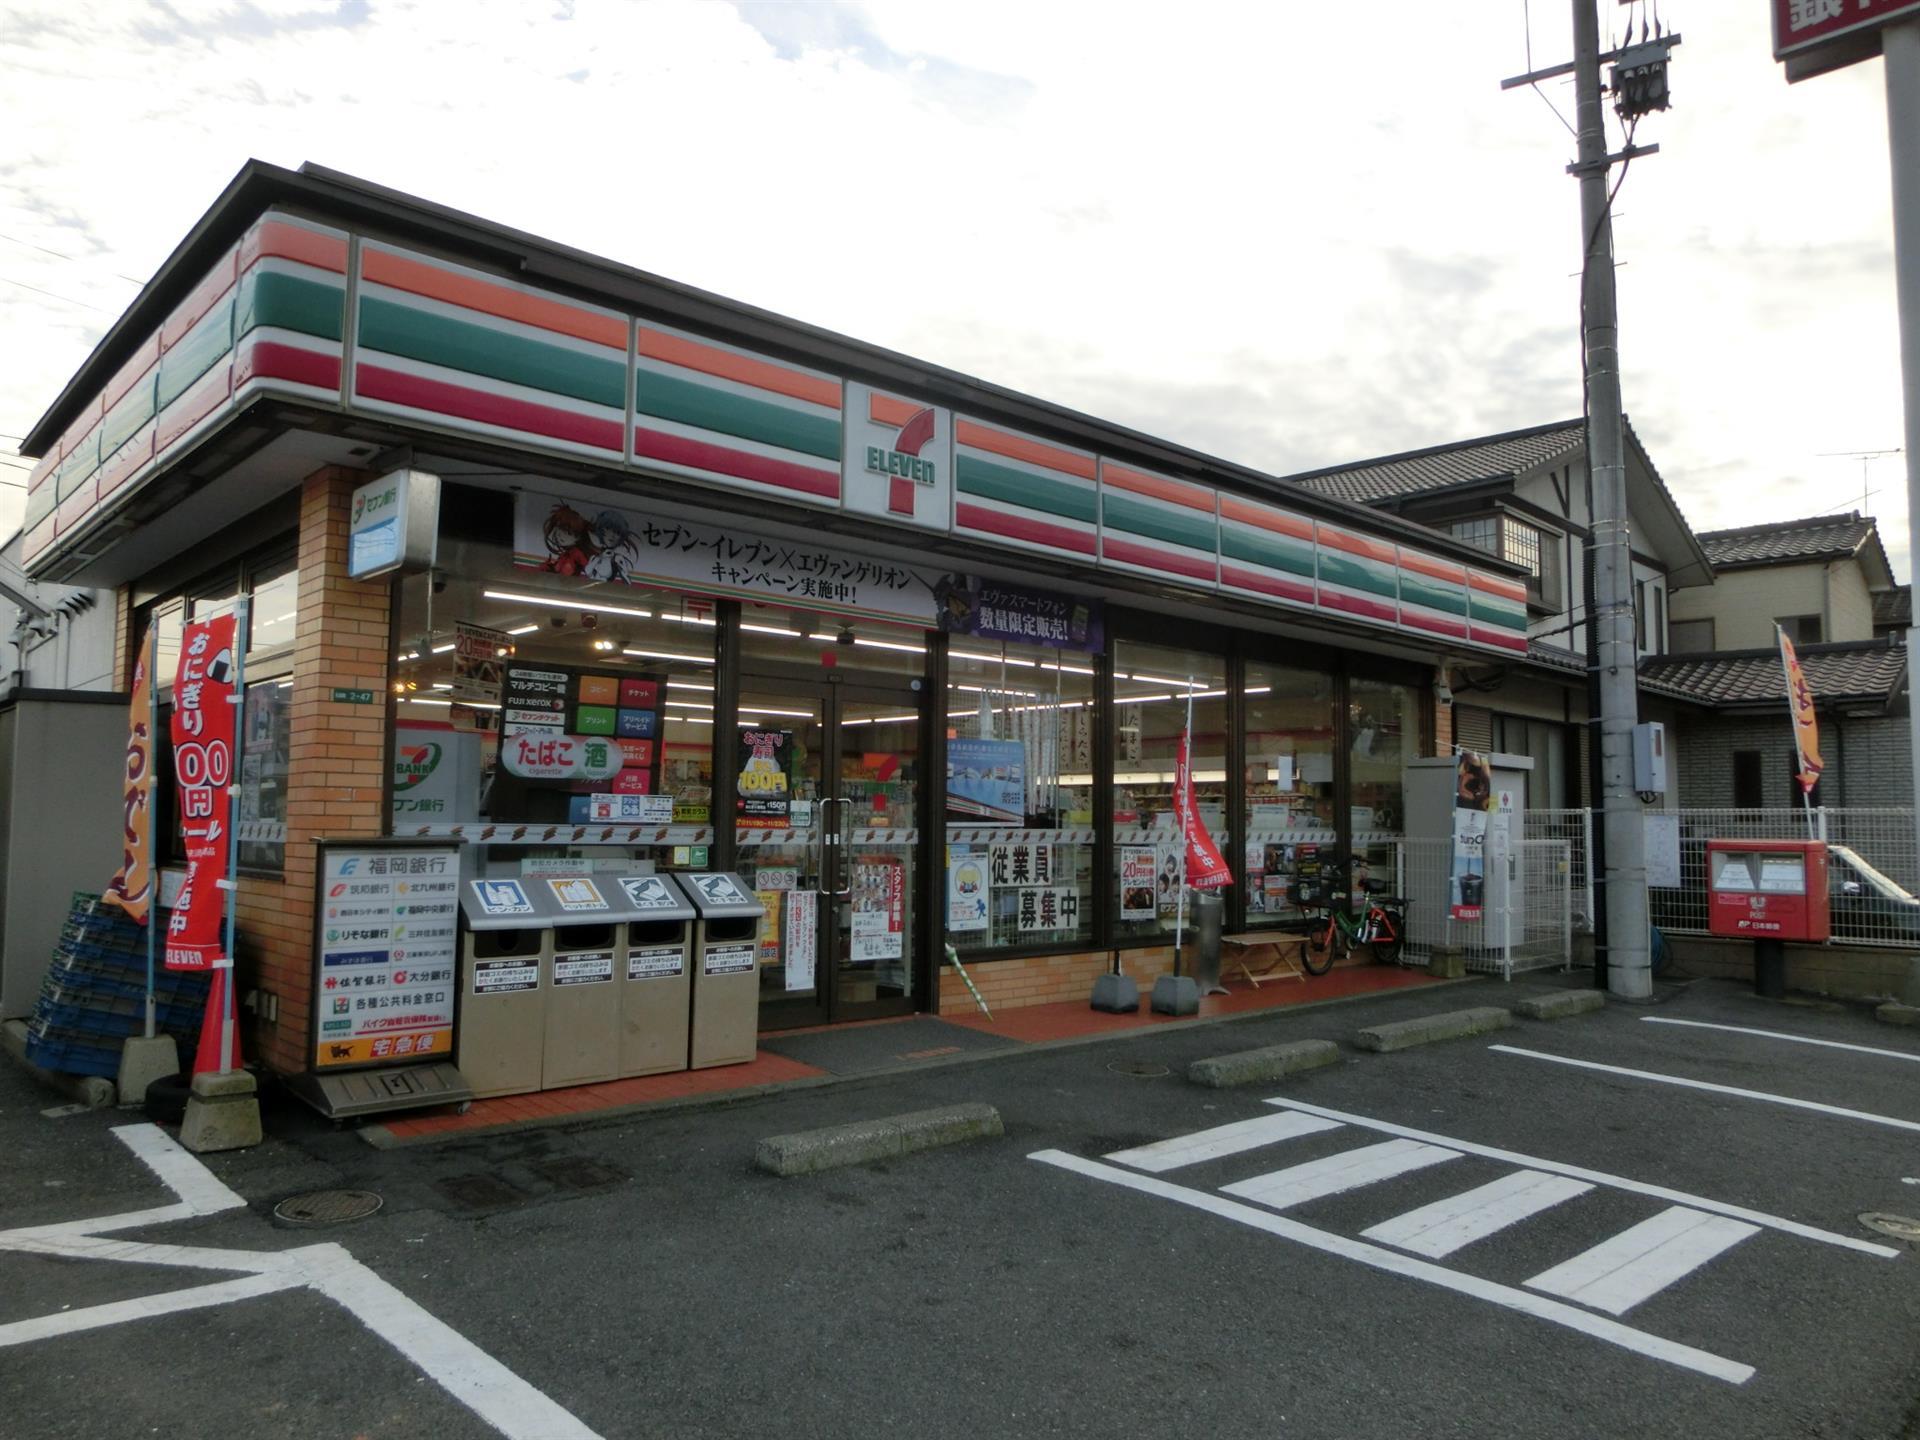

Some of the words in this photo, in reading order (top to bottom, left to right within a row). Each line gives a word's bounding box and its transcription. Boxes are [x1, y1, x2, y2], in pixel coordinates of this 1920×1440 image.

[367, 488, 397, 512] セブン銀行
[980, 606, 1069, 641] 数量限定販売!
[181, 632, 210, 736] おにぎり
[628, 689, 649, 697] チケット
[744, 731, 784, 747] おにぎり
[174, 739, 228, 787] 00
[518, 739, 574, 766] たばこ
[585, 742, 608, 768] 酒
[619, 782, 643, 790] サービス
[739, 771, 788, 792] 100円
[185, 786, 212, 817] 円
[180, 820, 223, 841] ール
[368, 857, 447, 875] 福岡銀行
[992, 844, 1050, 885] 従業員
[410, 882, 456, 892] 北九州銀行
[1020, 888, 1078, 928] 募集中
[341, 928, 389, 940] りそな銀行
[409, 969, 452, 982] 大分銀行
[356, 992, 446, 1010] 各種公共料金窓口
[372, 1033, 434, 1057] 宅急便
